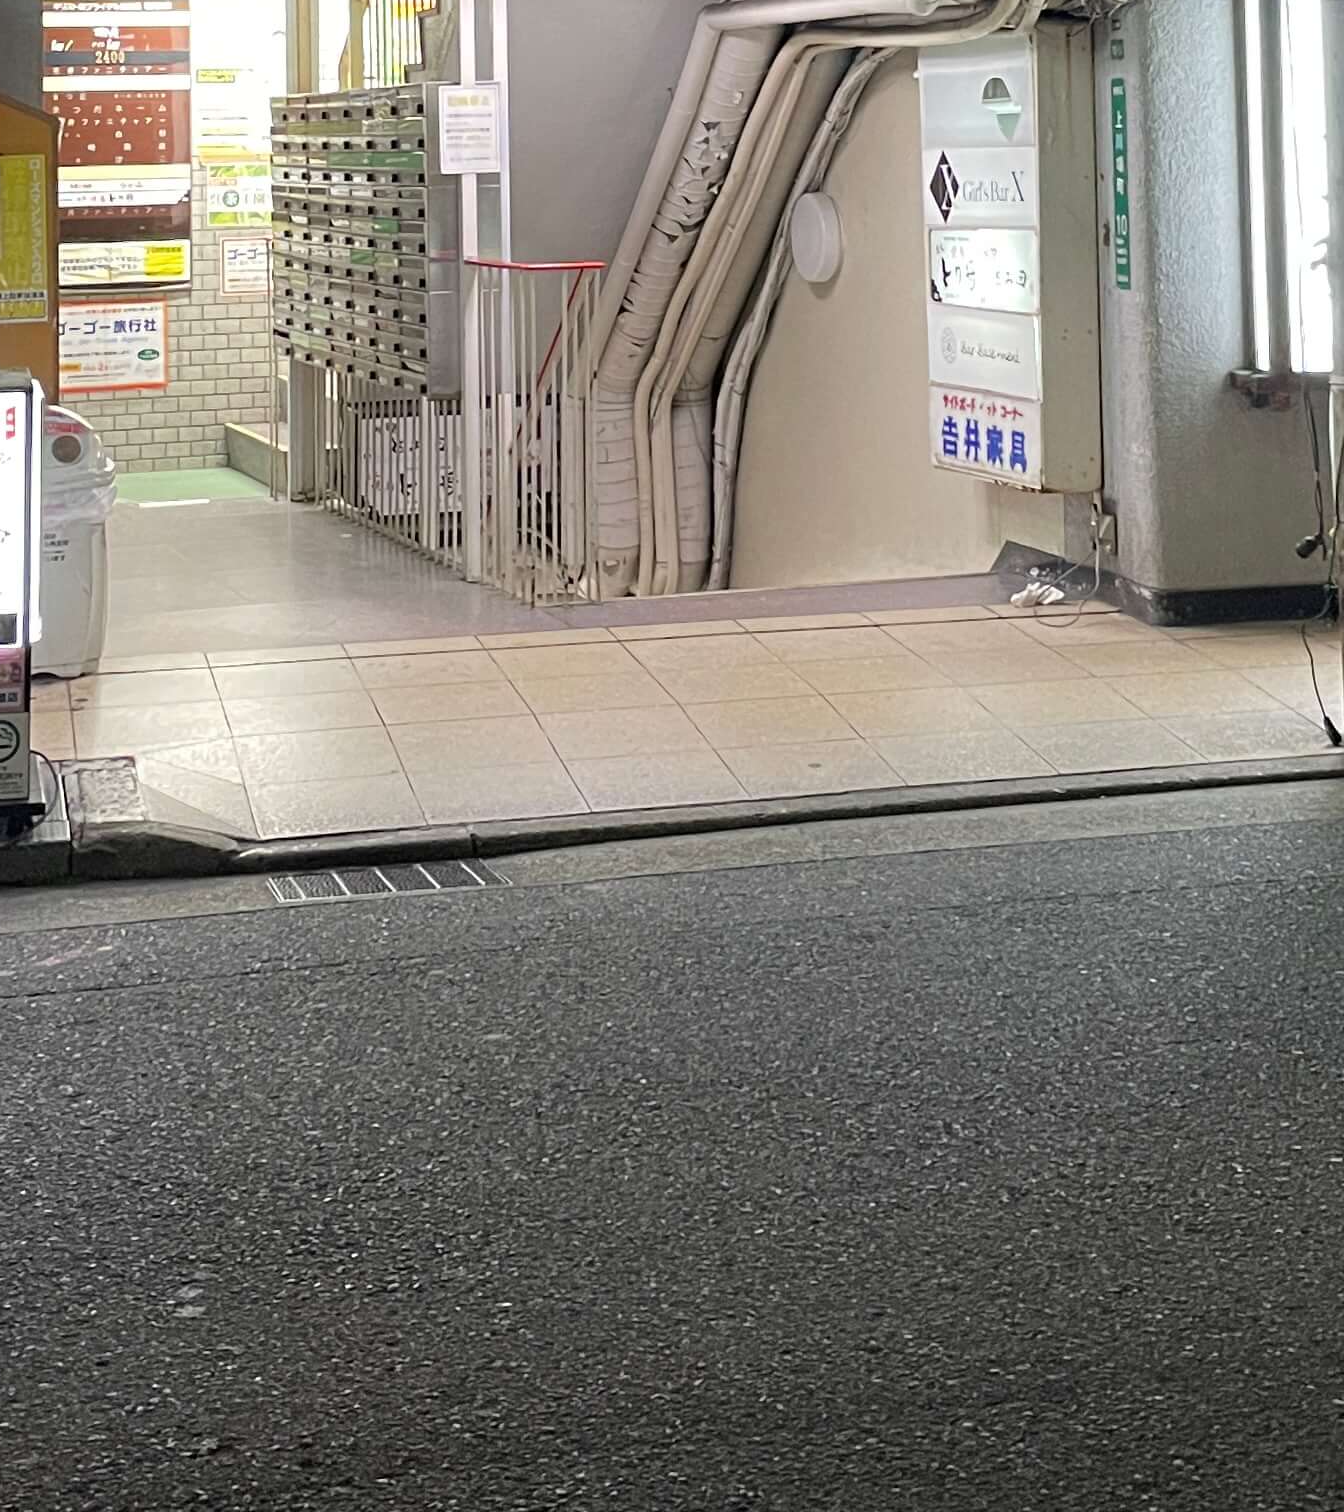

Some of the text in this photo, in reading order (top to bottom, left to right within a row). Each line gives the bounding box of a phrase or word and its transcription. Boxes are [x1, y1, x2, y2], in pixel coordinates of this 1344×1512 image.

[962, 170, 1025, 202] Girl's Bar X
[942, 415, 1028, 473] 吉井家具
